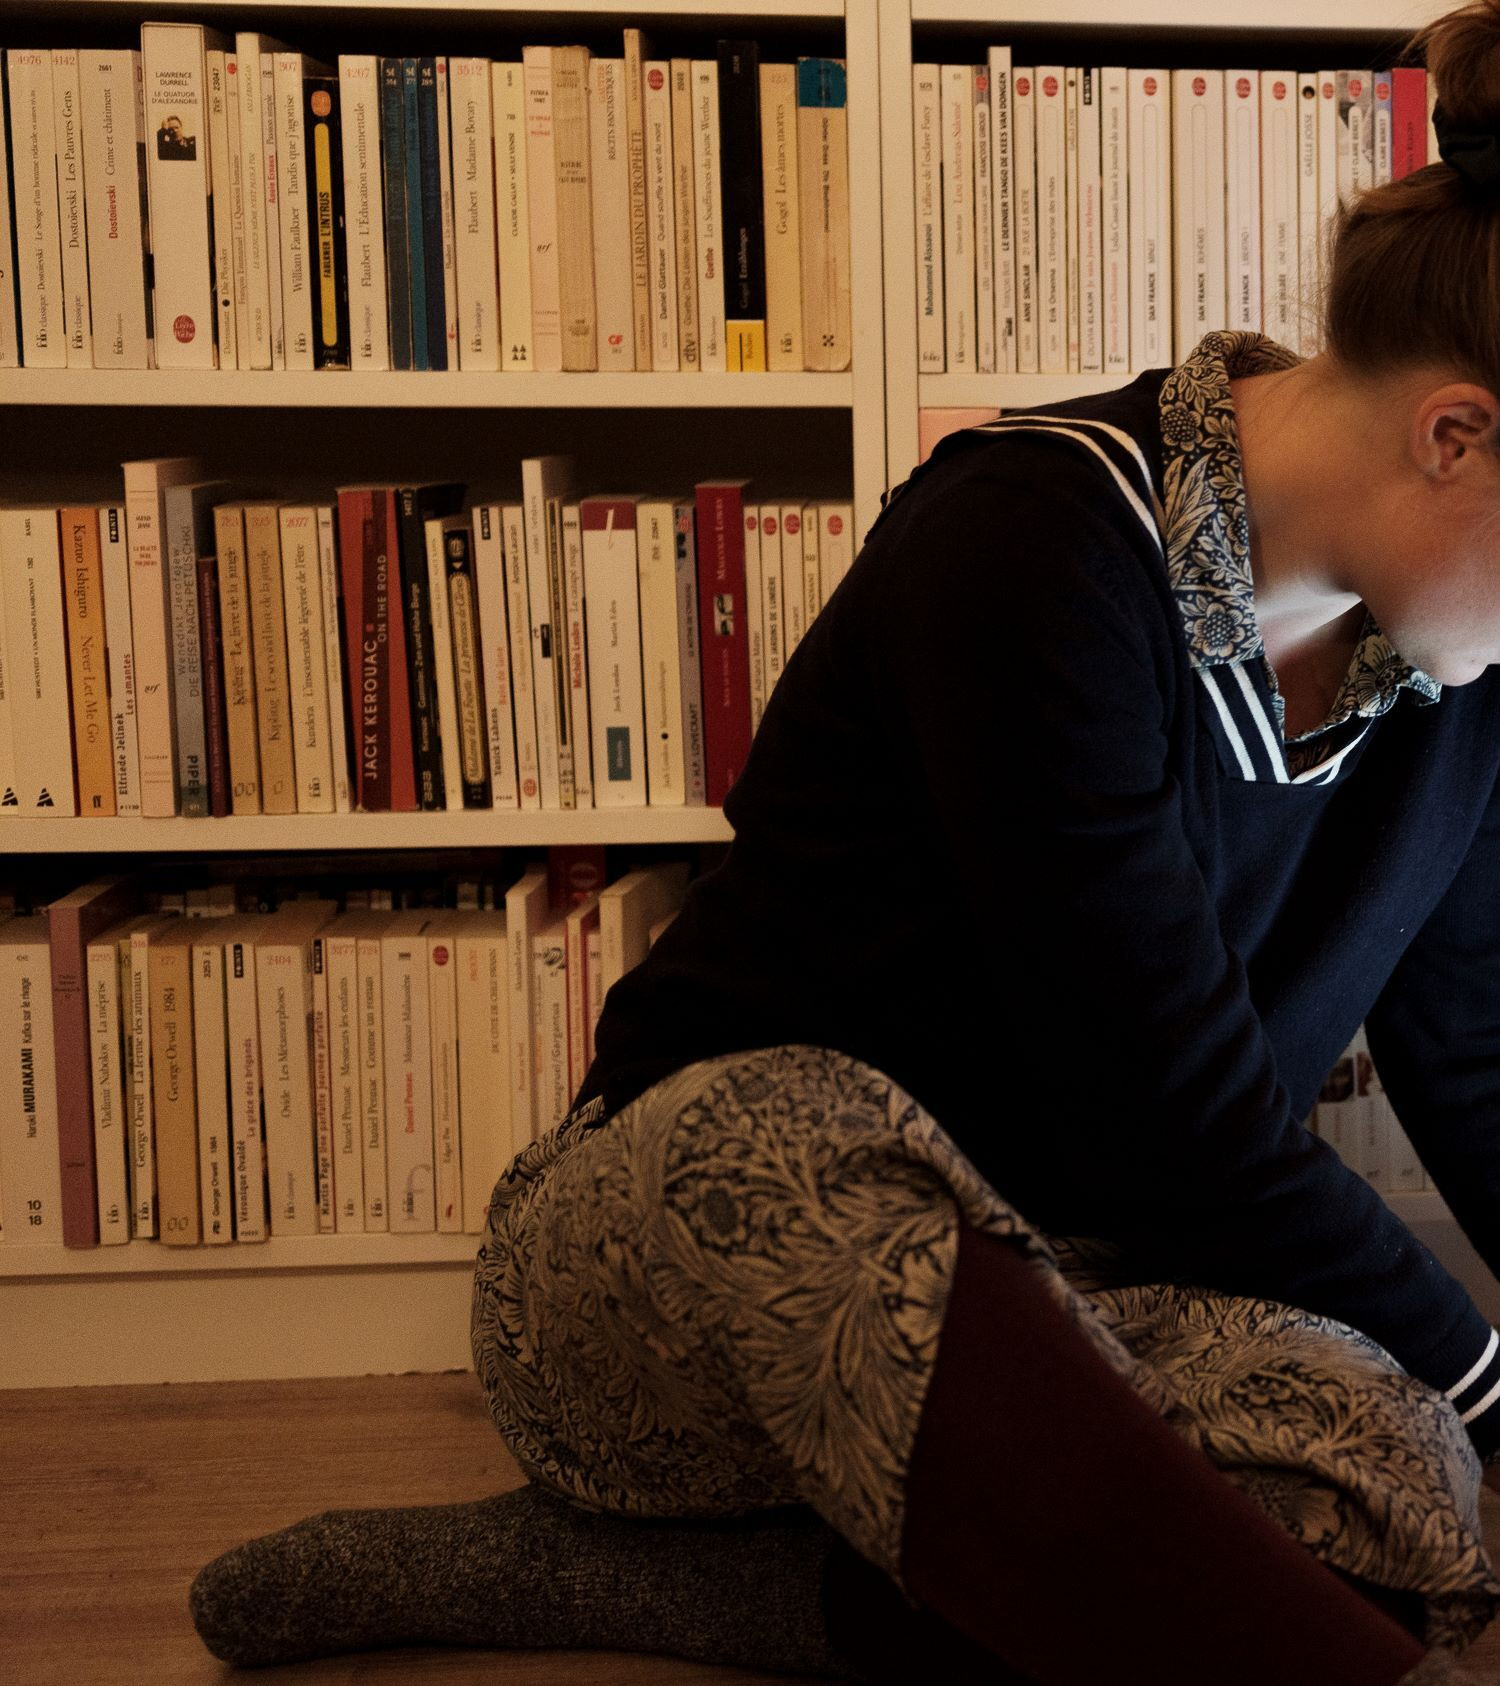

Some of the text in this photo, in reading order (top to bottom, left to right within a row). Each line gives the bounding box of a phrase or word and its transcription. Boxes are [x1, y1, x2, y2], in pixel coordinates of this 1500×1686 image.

[153, 90, 196, 98] LE QUATUOR
[700, 95, 710, 130] Werther
[653, 122, 661, 141] nord
[654, 144, 662, 152] du
[62, 90, 79, 248] Dostoïevski Les Pauvres Gens
[101, 88, 118, 239] Dostoïevski Crime et châtiment
[465, 98, 479, 234] Flaubert Madame Bovary
[654, 154, 663, 174] vent
[702, 160, 710, 169] du
[998, 72, 1010, 251] LE DERNIER TANGO DE KEES VAN DONGEN
[284, 94, 302, 292] William Faulkner Tandis que j'agonise
[354, 102, 372, 287] Flaubert L'Éducation sentimentale
[630, 129, 646, 287] LE JARDIN DU PROPHÈTE
[702, 171, 712, 221] Souffrances
[319, 192, 331, 278] FAULKNER L'INTRUS
[657, 215, 666, 241] Quand
[705, 224, 713, 238] Les
[657, 248, 666, 289] Glattauer
[705, 248, 714, 279] Goethe
[659, 292, 667, 320] Daniel
[925, 264, 934, 316] Mohammed
[1147, 272, 1156, 321] DAN FRANCK
[1197, 272, 1206, 321] DAN FRANCK
[1242, 274, 1250, 323] DAN FRANCK
[1048, 307, 1056, 323] Erik
[72, 525, 90, 618] Kazuo Ishiguro
[226, 583, 239, 592] la
[185, 597, 197, 635] NACH
[227, 594, 240, 609] de
[377, 554, 388, 642] ON THE ROAD
[768, 611, 778, 621] DE
[228, 611, 241, 637] livre
[186, 639, 199, 673] REISE
[229, 640, 242, 656] Le
[80, 635, 98, 743] Never Let Me Go
[122, 653, 134, 715] Les amantes
[188, 675, 200, 697] DIE
[232, 665, 246, 706] Kipling
[364, 639, 377, 781] JACK KEROUAC
[115, 713, 128, 795] Elfriede Jelinek
[187, 754, 200, 795] PIPER
[20, 1022, 32, 1044] Kafka
[162, 987, 180, 1102] George Orwell 1984
[95, 980, 113, 1129] Vladimir Nabokov La méprise
[129, 970, 148, 1168] George Orwell La ferme des animaux
[277, 1064, 290, 1082] Les
[21, 1047, 36, 1113] MURAKAMI
[27, 1199, 42, 1211] 10
[28, 1215, 42, 1226] 18
